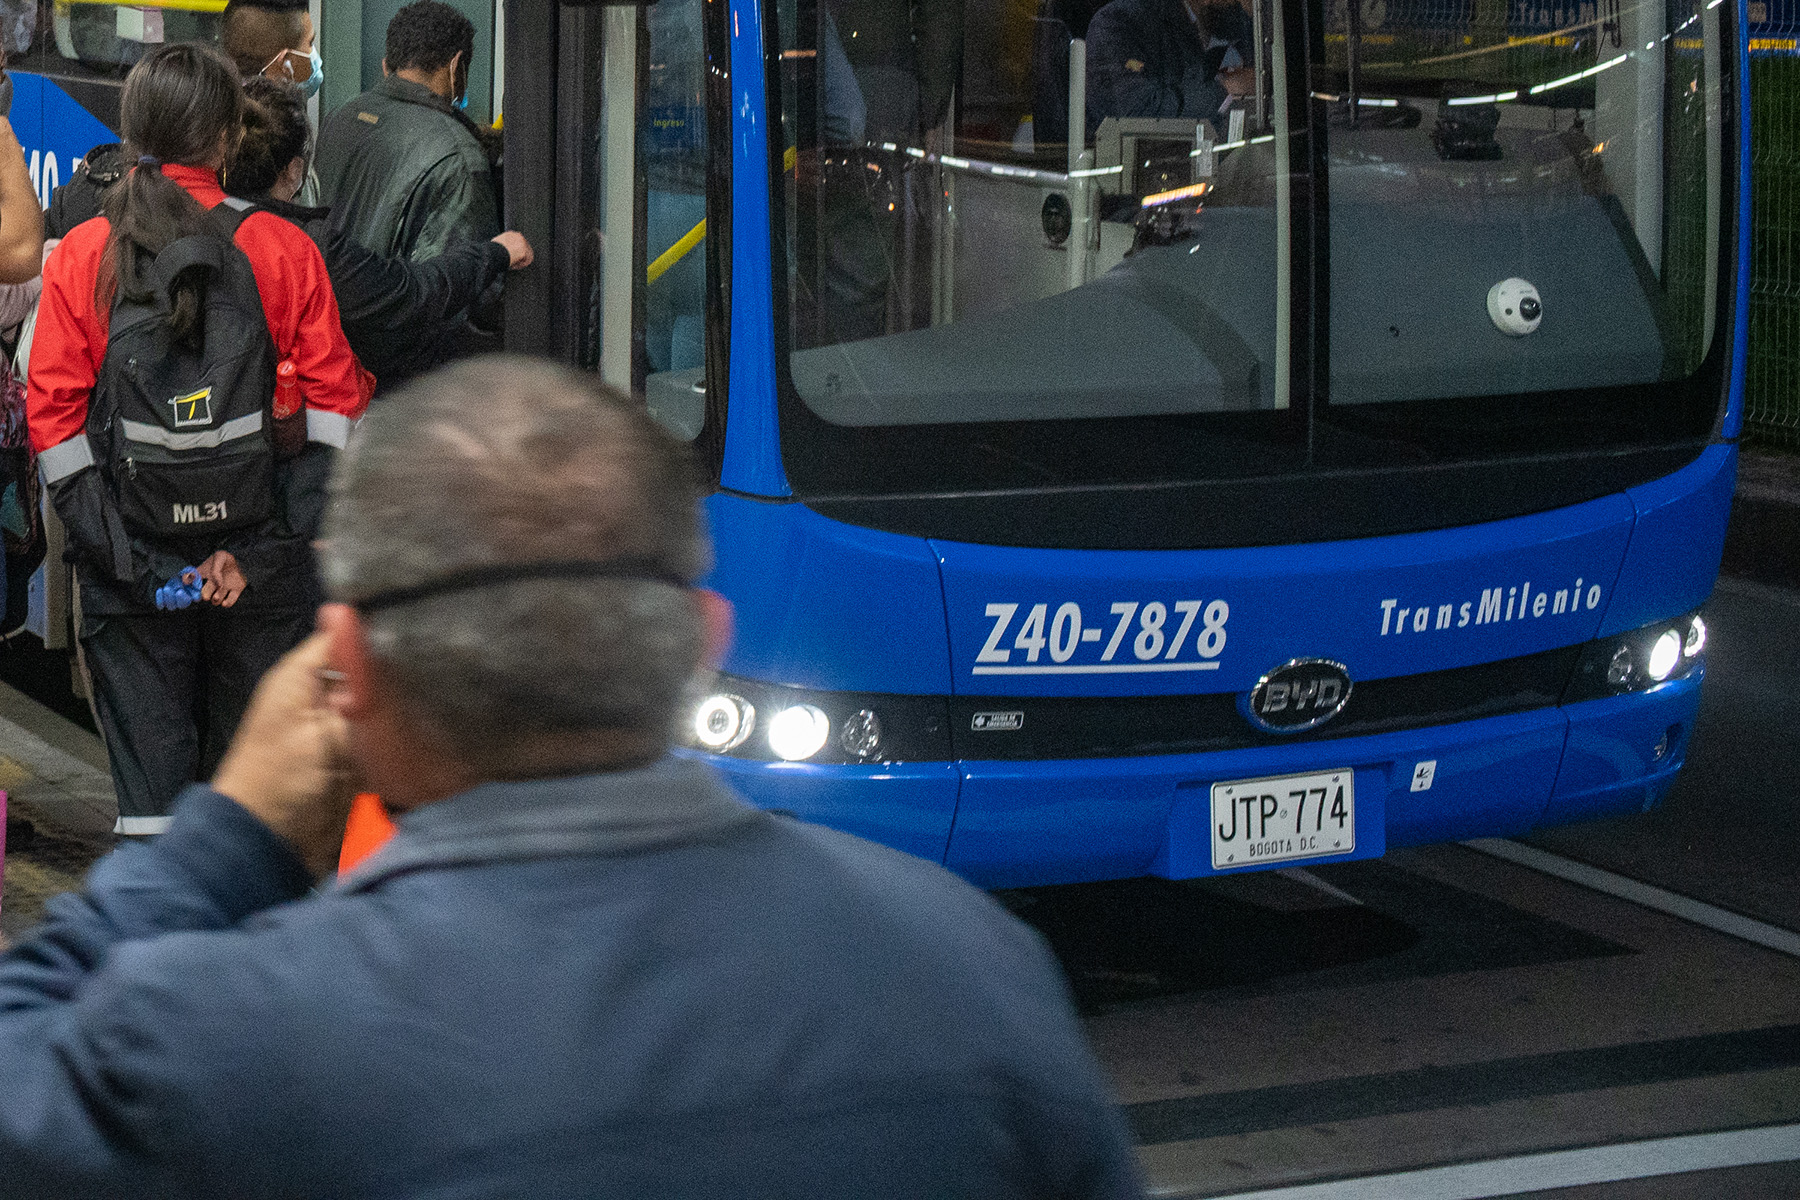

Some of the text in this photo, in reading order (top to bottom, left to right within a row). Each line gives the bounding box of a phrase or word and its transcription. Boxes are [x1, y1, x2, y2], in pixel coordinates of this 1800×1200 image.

[173, 500, 228, 524] ML31
[1379, 576, 1603, 637] TransMilenio
[974, 599, 1231, 666] Z40-7878
[1260, 675, 1344, 715] BYD
[1218, 784, 1349, 842] JTP 774
[1249, 836, 1319, 858] BOGOTA D.C.
